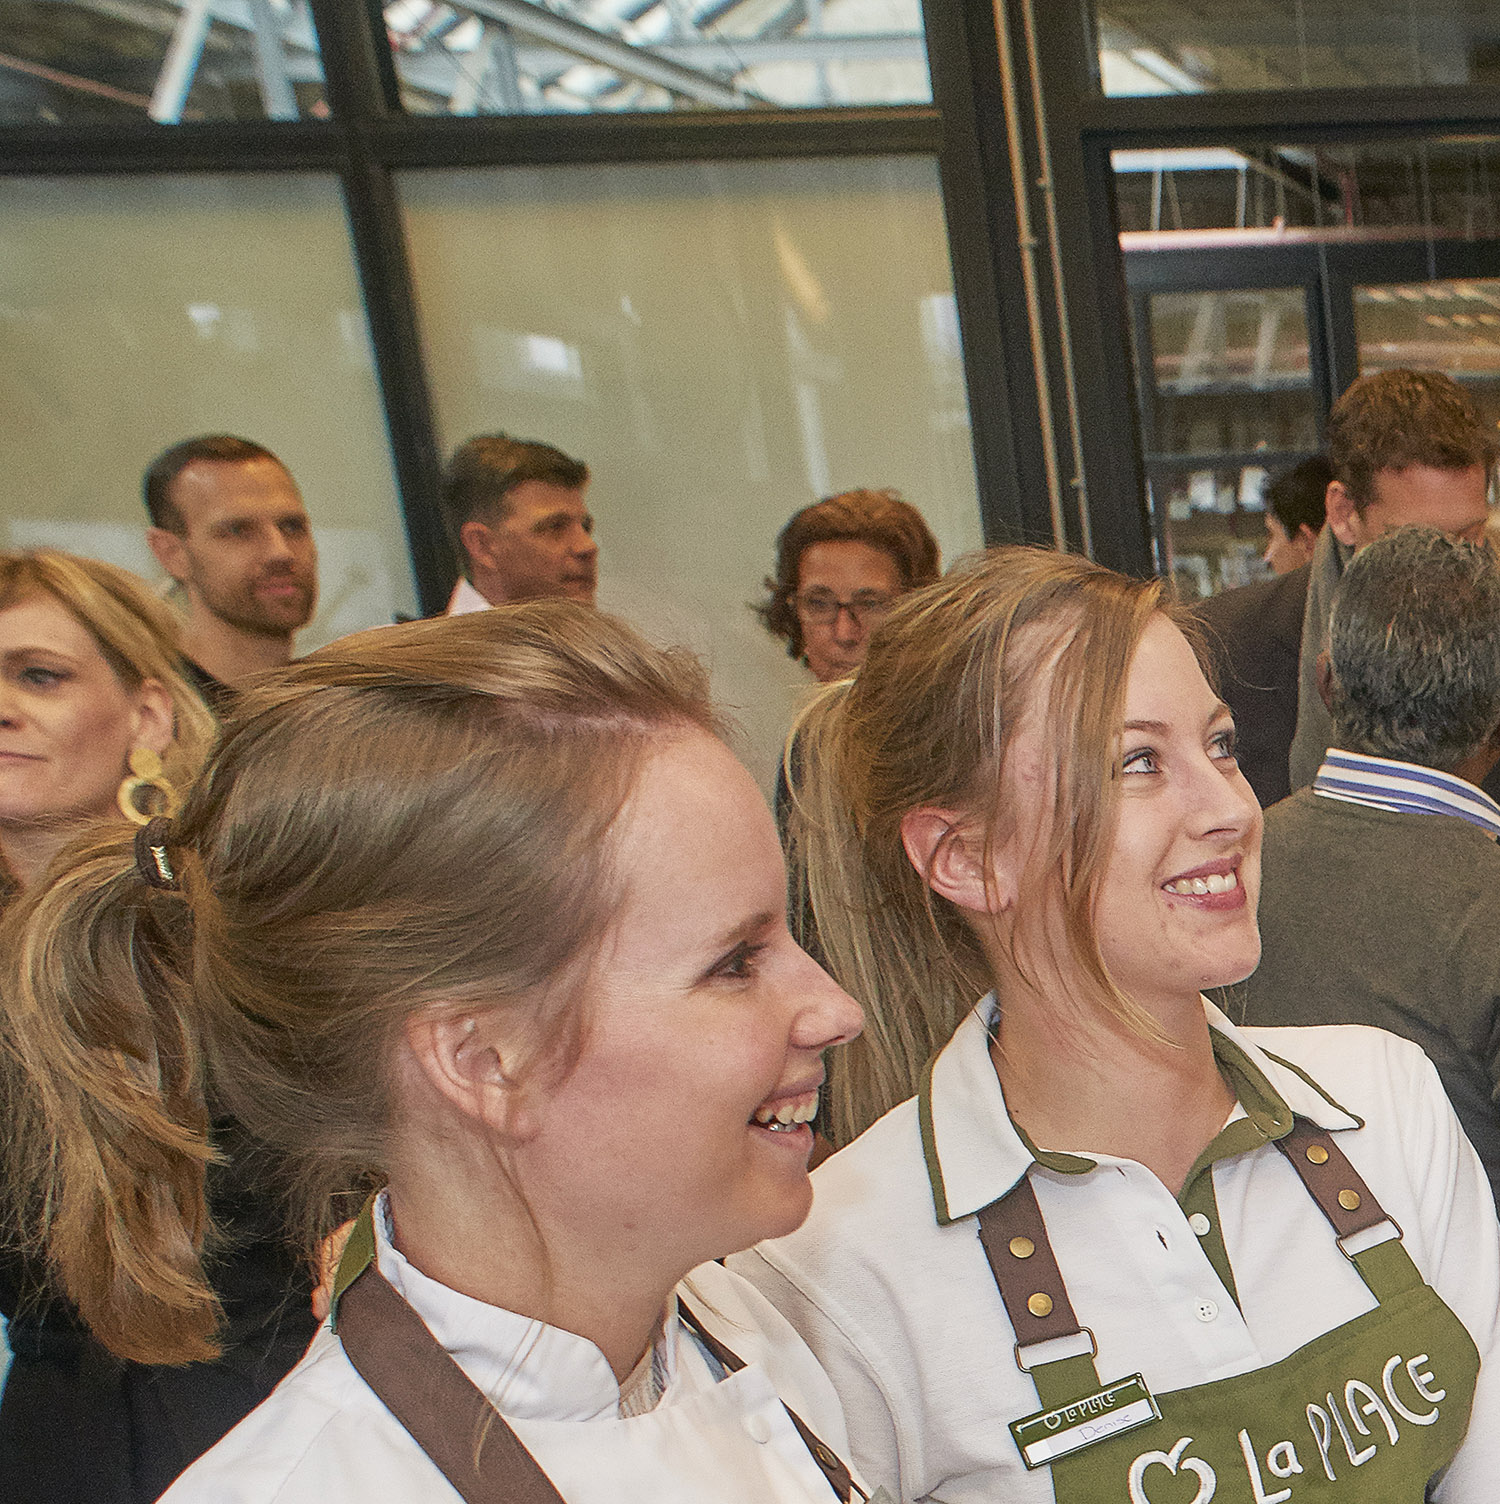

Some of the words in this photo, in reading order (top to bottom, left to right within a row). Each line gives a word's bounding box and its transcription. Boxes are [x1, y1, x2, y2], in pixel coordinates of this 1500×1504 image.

[1064, 1409, 1077, 1423] La
[1077, 1390, 1116, 1417] PLACE
[1306, 1353, 1447, 1482] PLACE
